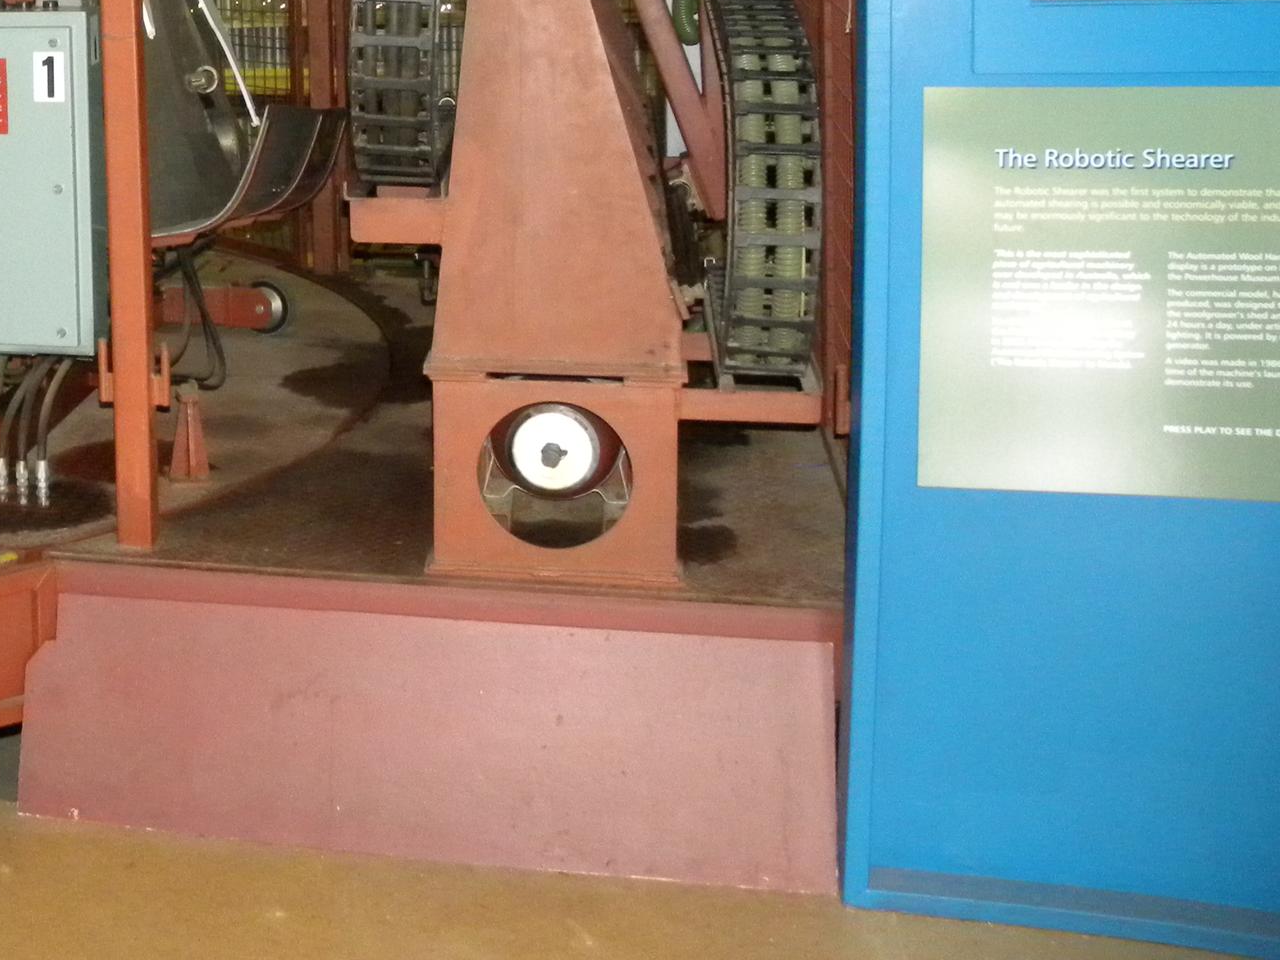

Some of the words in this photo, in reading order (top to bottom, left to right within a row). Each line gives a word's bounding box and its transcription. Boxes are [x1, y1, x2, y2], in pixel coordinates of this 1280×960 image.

[42, 56, 55, 98] 1
[994, 147, 1037, 169] The
[1045, 147, 1135, 169] Robotic
[1142, 148, 1235, 169] Shearer
[994, 186, 1012, 195] The
[1014, 187, 1049, 195] Robotic
[1052, 187, 1088, 195] Shearer
[1111, 187, 1128, 196] the
[1130, 187, 1148, 196] first
[1151, 189, 1185, 198] system
[1200, 188, 1263, 197] demonstrate
[994, 200, 1046, 208] automated
[1048, 199, 1088, 210] shearing
[1090, 200, 1098, 208] is
[1100, 200, 1140, 210] possible
[1142, 200, 1161, 209] and
[1163, 200, 1225, 211] economically
[1228, 200, 1260, 210] viable,
[994, 213, 1013, 222] may
[1016, 211, 1028, 220] be
[1030, 212, 1085, 222] enormously
[1087, 211, 1137, 222] significant
[1139, 212, 1151, 220] to
[1152, 212, 1169, 220] the
[1171, 212, 1225, 224] technology
[1228, 212, 1238, 222] of
[1241, 213, 1258, 222] the
[1168, 251, 1184, 260] The
[1186, 251, 1237, 260] Automated
[1239, 251, 1263, 260] Wool
[1168, 261, 1198, 271] display
[1200, 262, 1208, 271] is
[1218, 264, 1262, 272] prototype
[1184, 273, 1238, 281] Powerhouse
[1240, 274, 1280, 282] Museum
[1185, 289, 1236, 298] commercial
[1239, 290, 1270, 299] model,
[1234, 301, 1275, 310] designed
[1166, 309, 1181, 318] the
[1184, 309, 1244, 320] woolgrower's
[1247, 311, 1268, 319] shed
[1166, 320, 1178, 328] 24
[1179, 320, 1206, 329] hours
[1215, 321, 1233, 330] day,
[1236, 321, 1263, 330] under
[1214, 332, 1221, 340] is
[1223, 332, 1264, 341] powered
[1266, 333, 1278, 342] by
[1165, 357, 1173, 365] A
[1174, 357, 1199, 366] video
[1220, 358, 1246, 367] made
[1186, 368, 1197, 376] of
[1199, 368, 1214, 377] the
[1216, 369, 1261, 378] machine's
[1164, 378, 1221, 387] demonstrate
[1222, 379, 1234, 387] its
[1163, 425, 1192, 434] PRESS
[1194, 425, 1217, 434] PLAY
[1219, 426, 1233, 435] TO
[1234, 427, 1253, 436] SEE
[1254, 427, 1273, 437] THE
